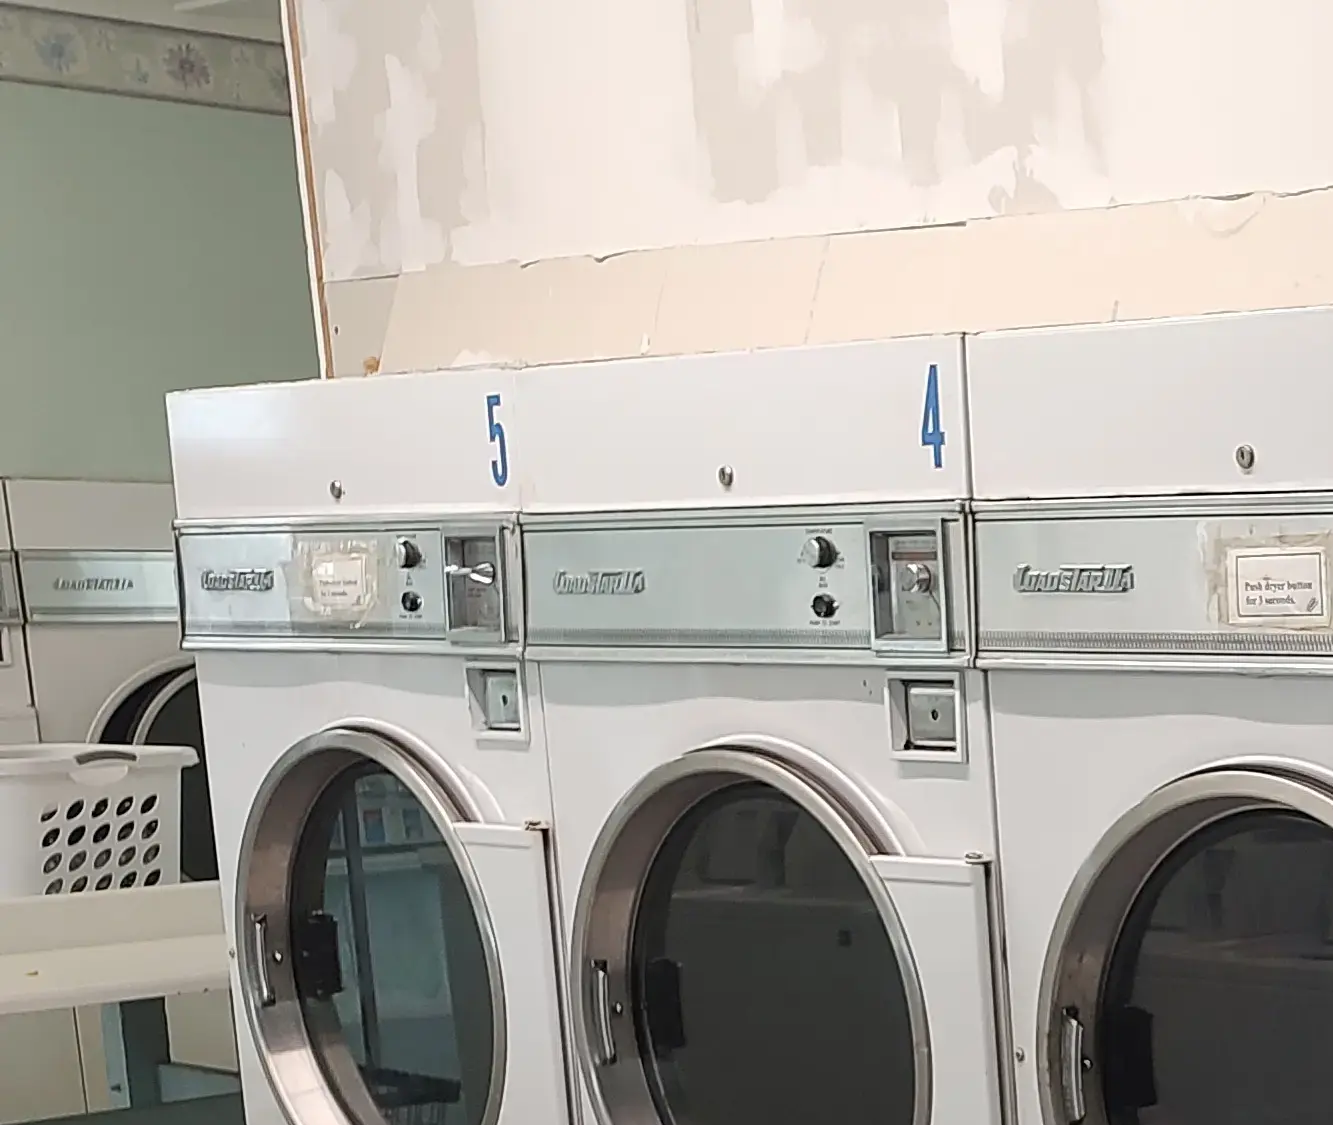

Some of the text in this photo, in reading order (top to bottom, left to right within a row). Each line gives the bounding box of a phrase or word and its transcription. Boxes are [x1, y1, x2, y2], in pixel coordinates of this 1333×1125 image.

[486, 393, 508, 487] 5
[921, 363, 946, 469] 4
[1244, 580, 1313, 593] Push dryer button
[1245, 596, 1257, 605] for
